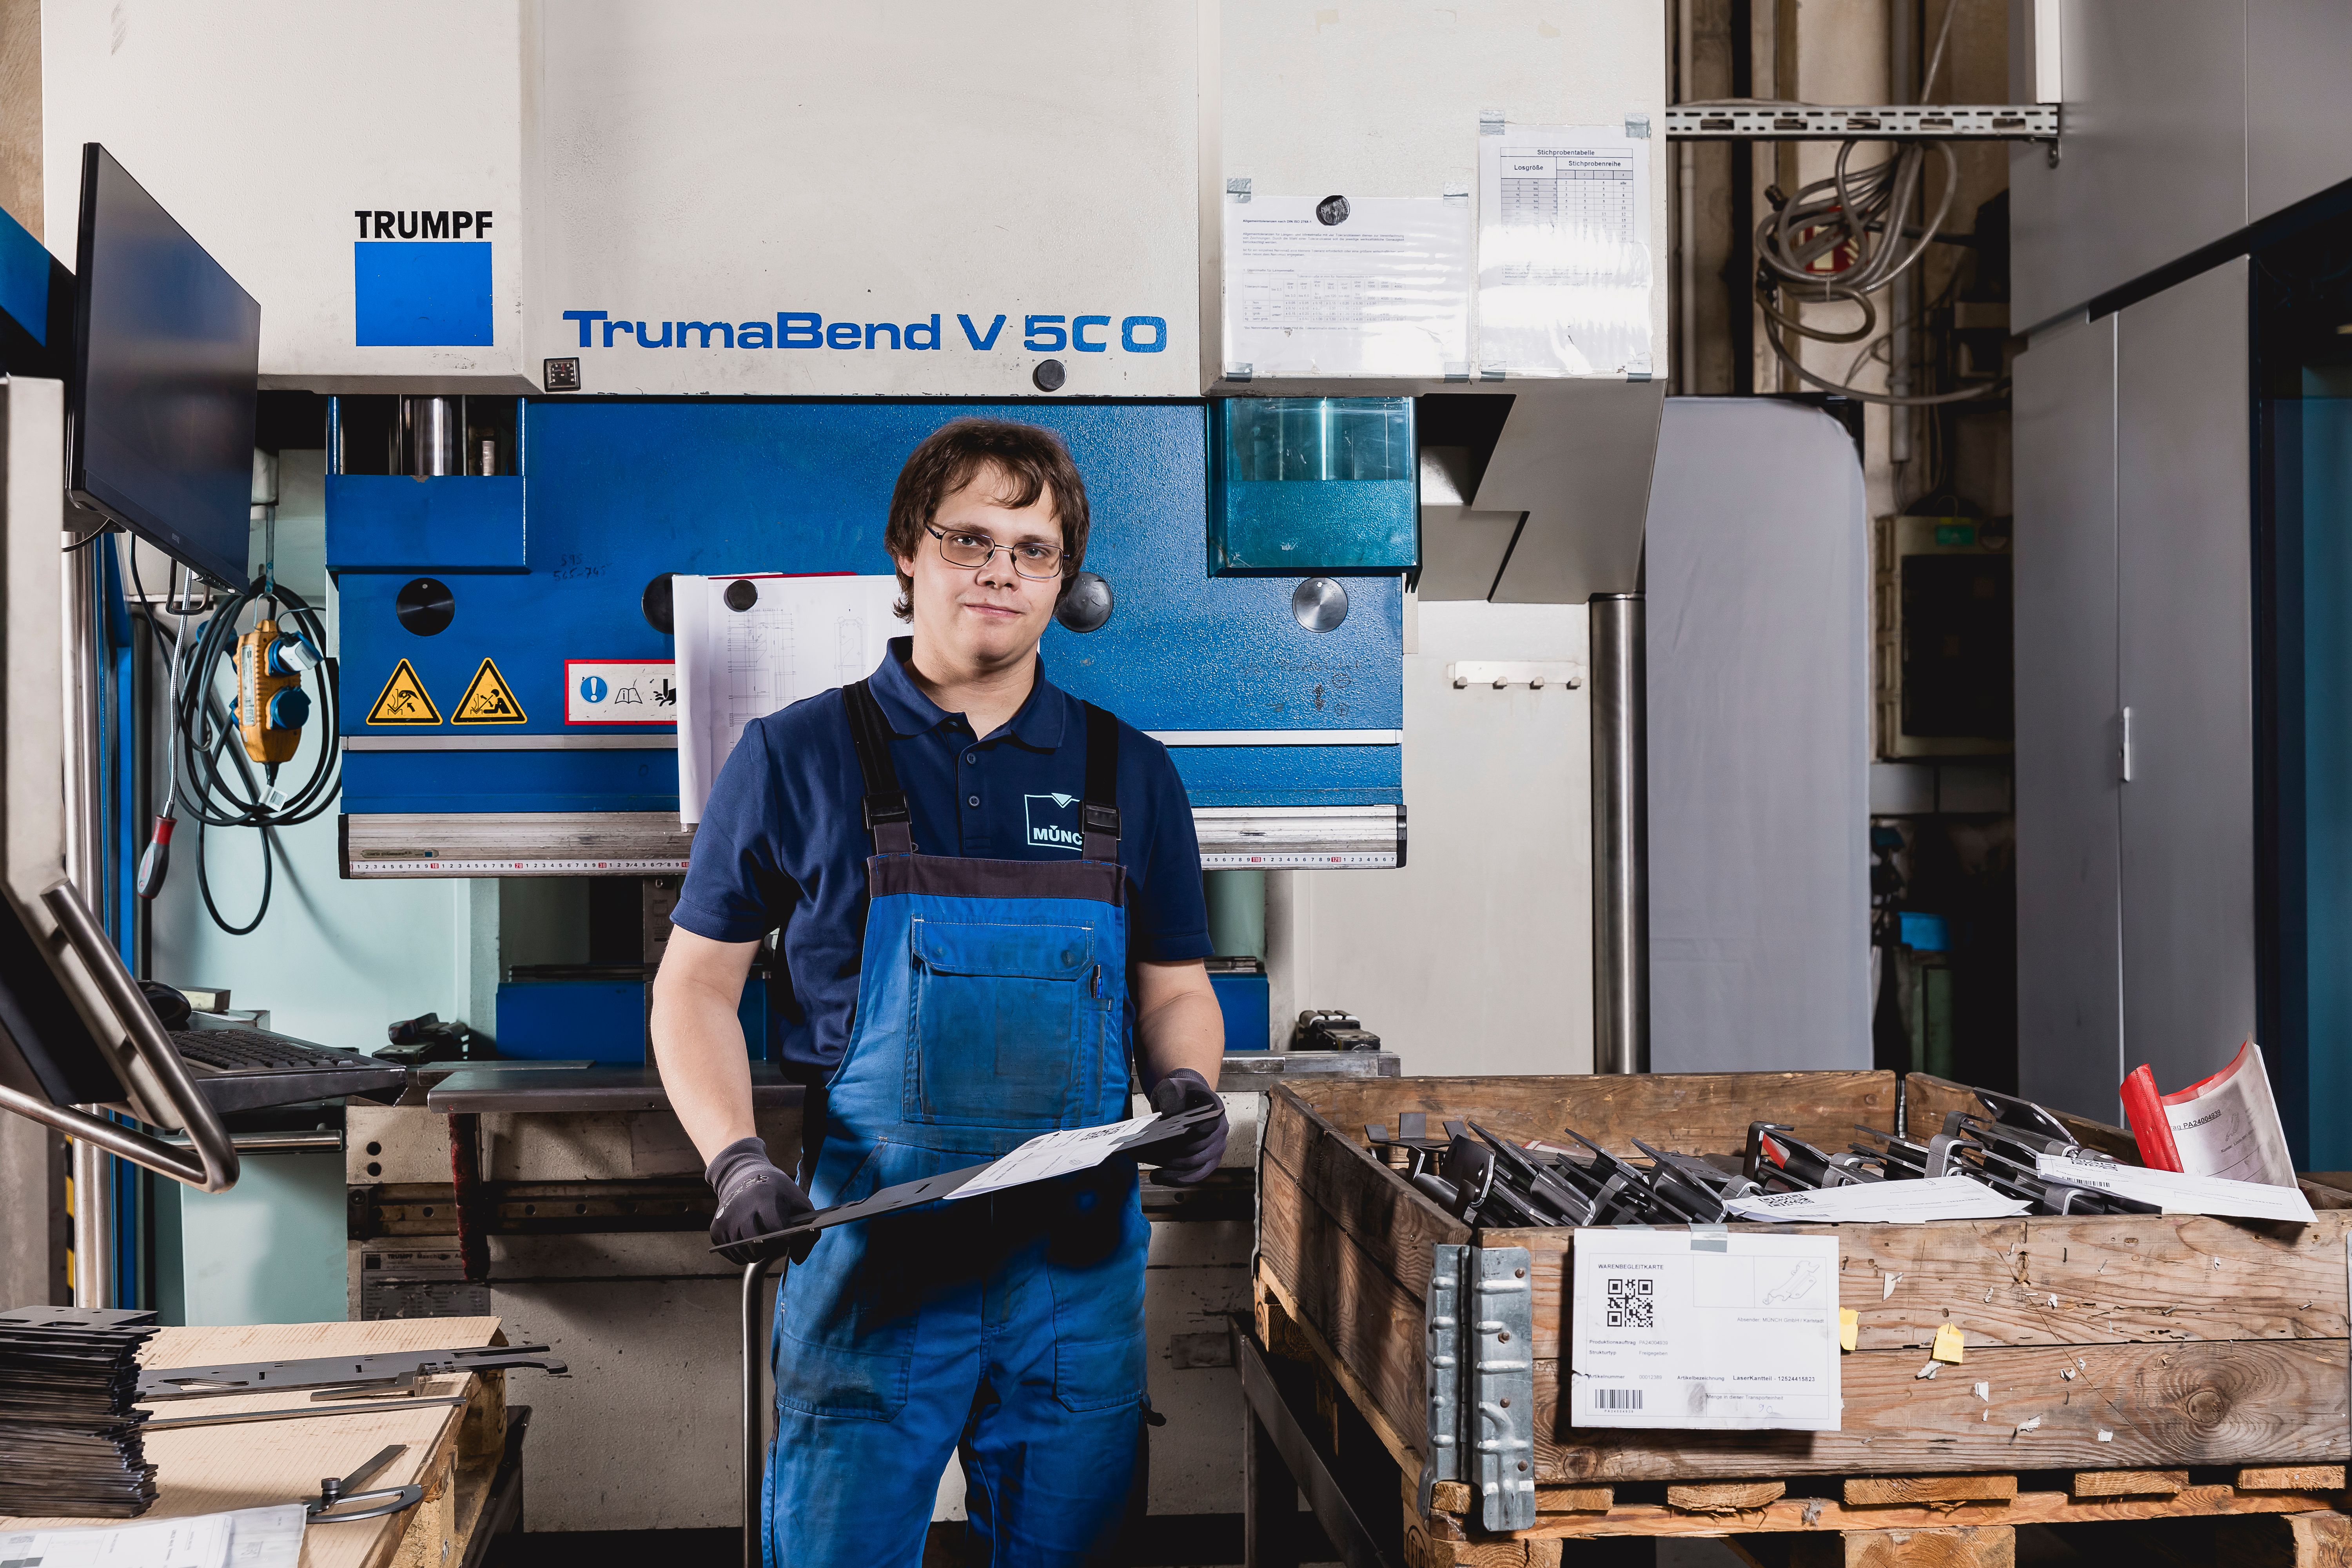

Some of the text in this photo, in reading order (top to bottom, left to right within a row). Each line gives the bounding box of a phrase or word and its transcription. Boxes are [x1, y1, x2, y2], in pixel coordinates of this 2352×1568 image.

[354, 211, 492, 239] TRUMPF
[563, 310, 941, 350] TrumaBend
[956, 314, 1007, 350] V
[2183, 1109, 2221, 1129] PA24004939
[2221, 1145, 2233, 1153] Kunde:
[1759, 1403, 1774, 1414] 90
